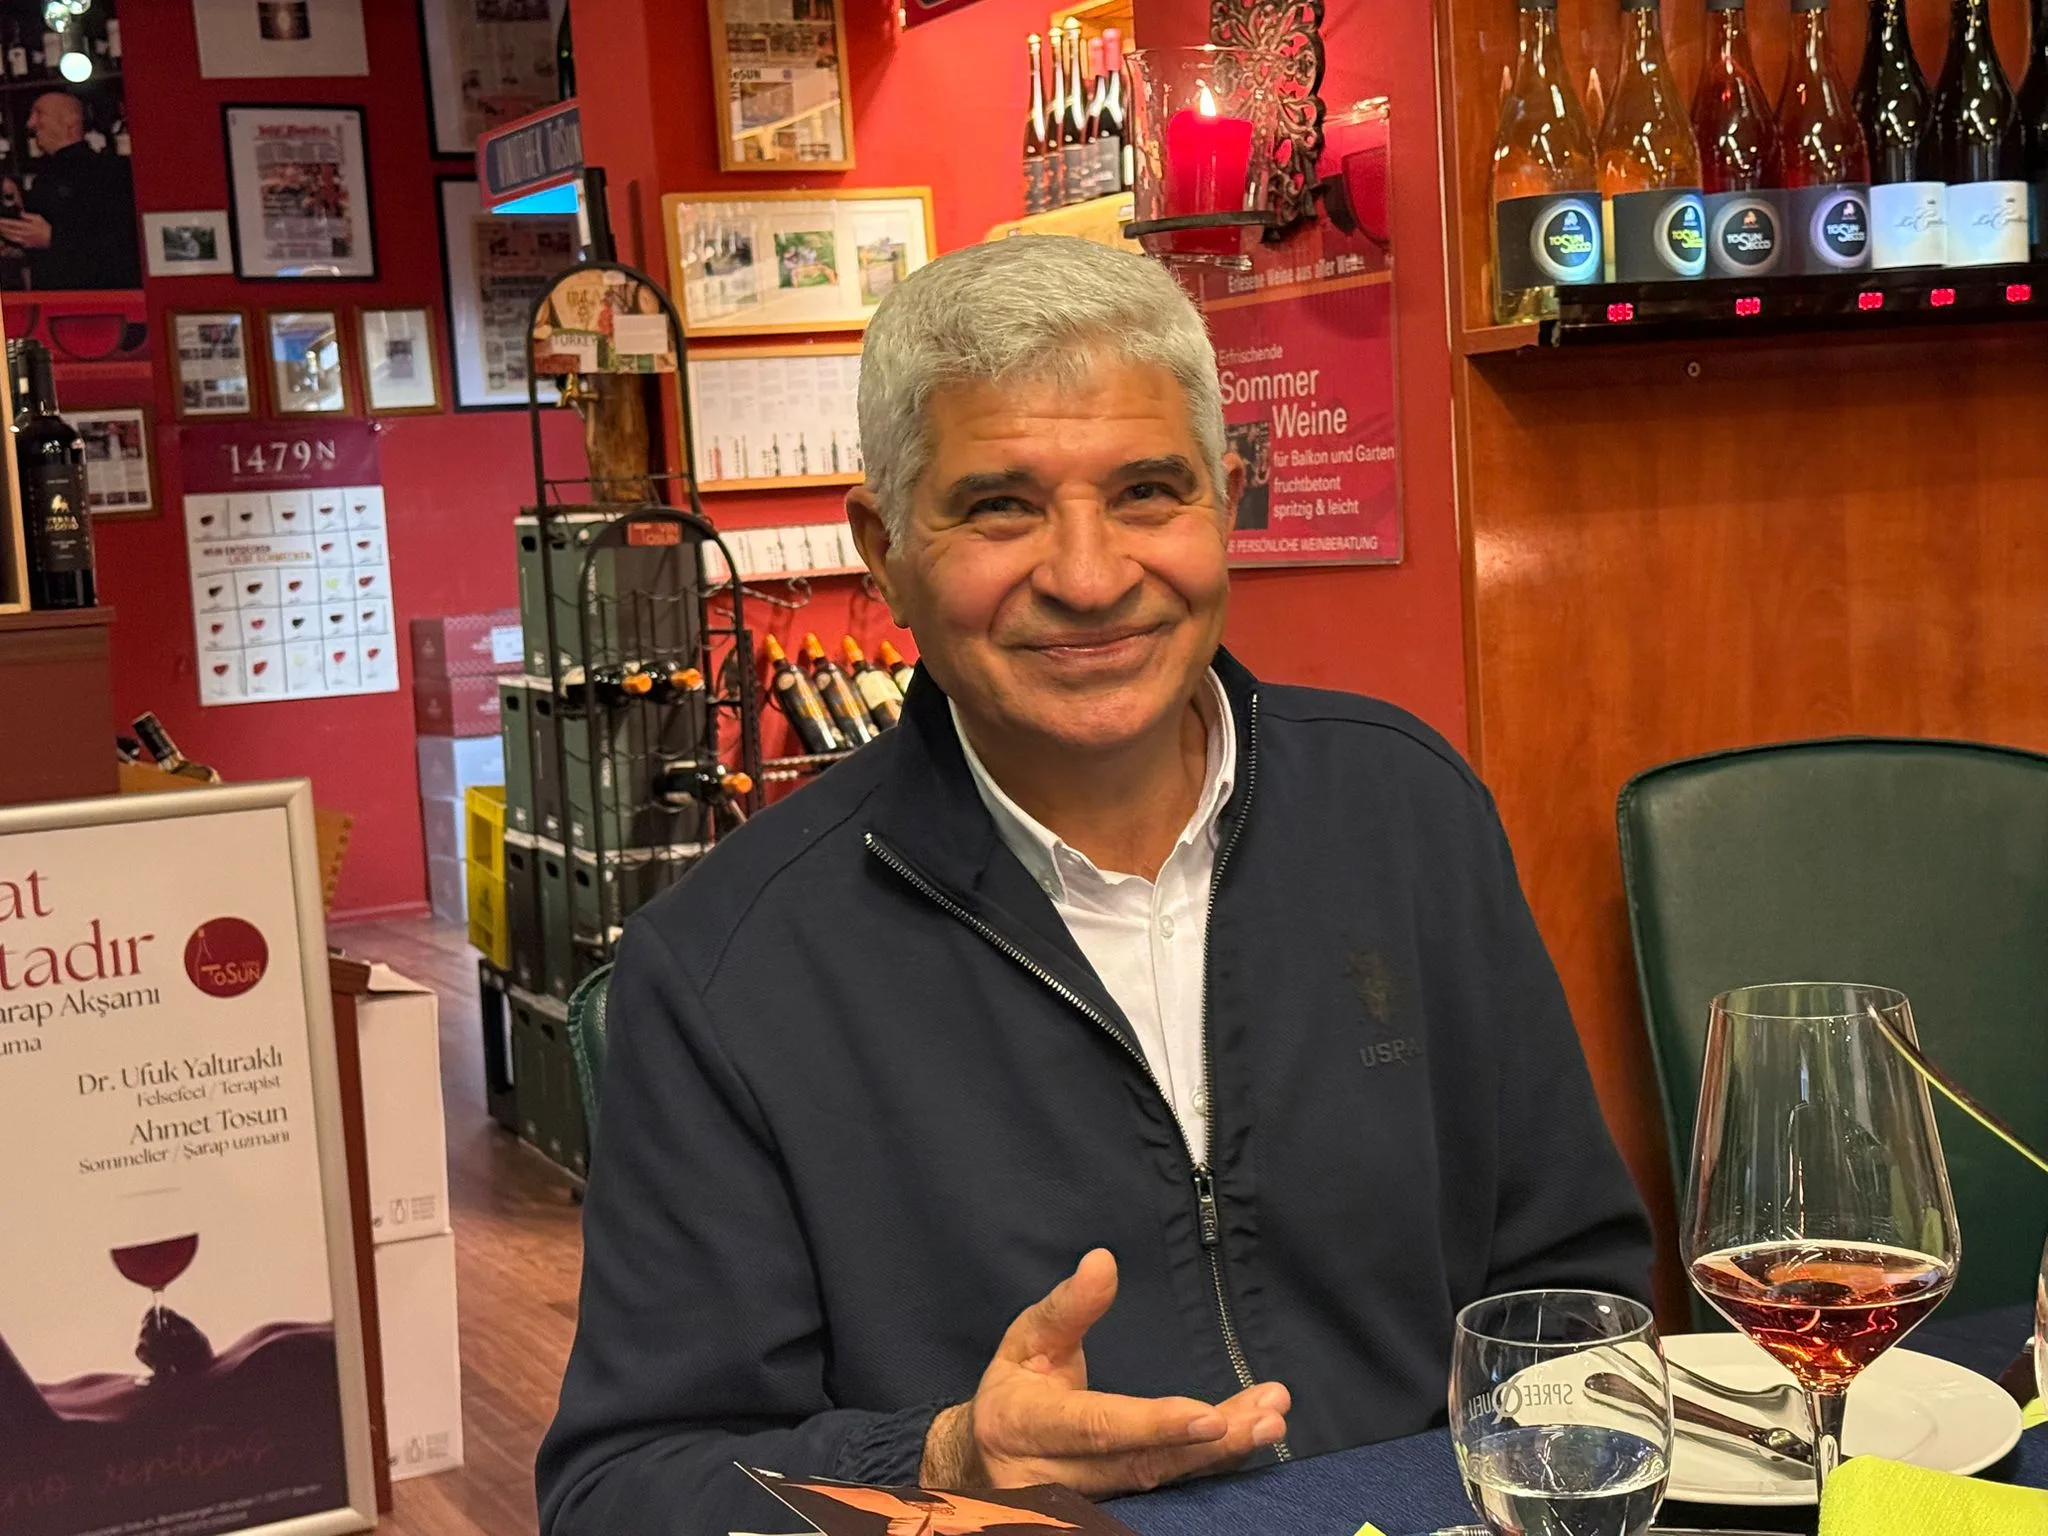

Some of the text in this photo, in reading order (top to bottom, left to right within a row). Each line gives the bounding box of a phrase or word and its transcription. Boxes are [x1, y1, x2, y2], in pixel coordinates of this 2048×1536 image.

[1218, 345, 1284, 367] Erfrischende
[1220, 369, 1320, 405] Sommer
[1271, 401, 1349, 439] Weine
[1274, 444, 1396, 468] für Balkon und Garten
[1274, 476, 1342, 494] fruchtbetont
[1273, 497, 1360, 520] spritzig & leicht
[60, 988, 161, 1019] Akşamı
[78, 1072, 116, 1096] Dr.
[122, 1060, 180, 1089] Ufuk
[137, 1085, 206, 1108] Felsefeci
[219, 1075, 281, 1096] Terapist
[129, 1105, 289, 1146] Ahmet Tosun
[79, 1147, 170, 1174] Sommelier
[183, 1138, 231, 1160] Şarap
